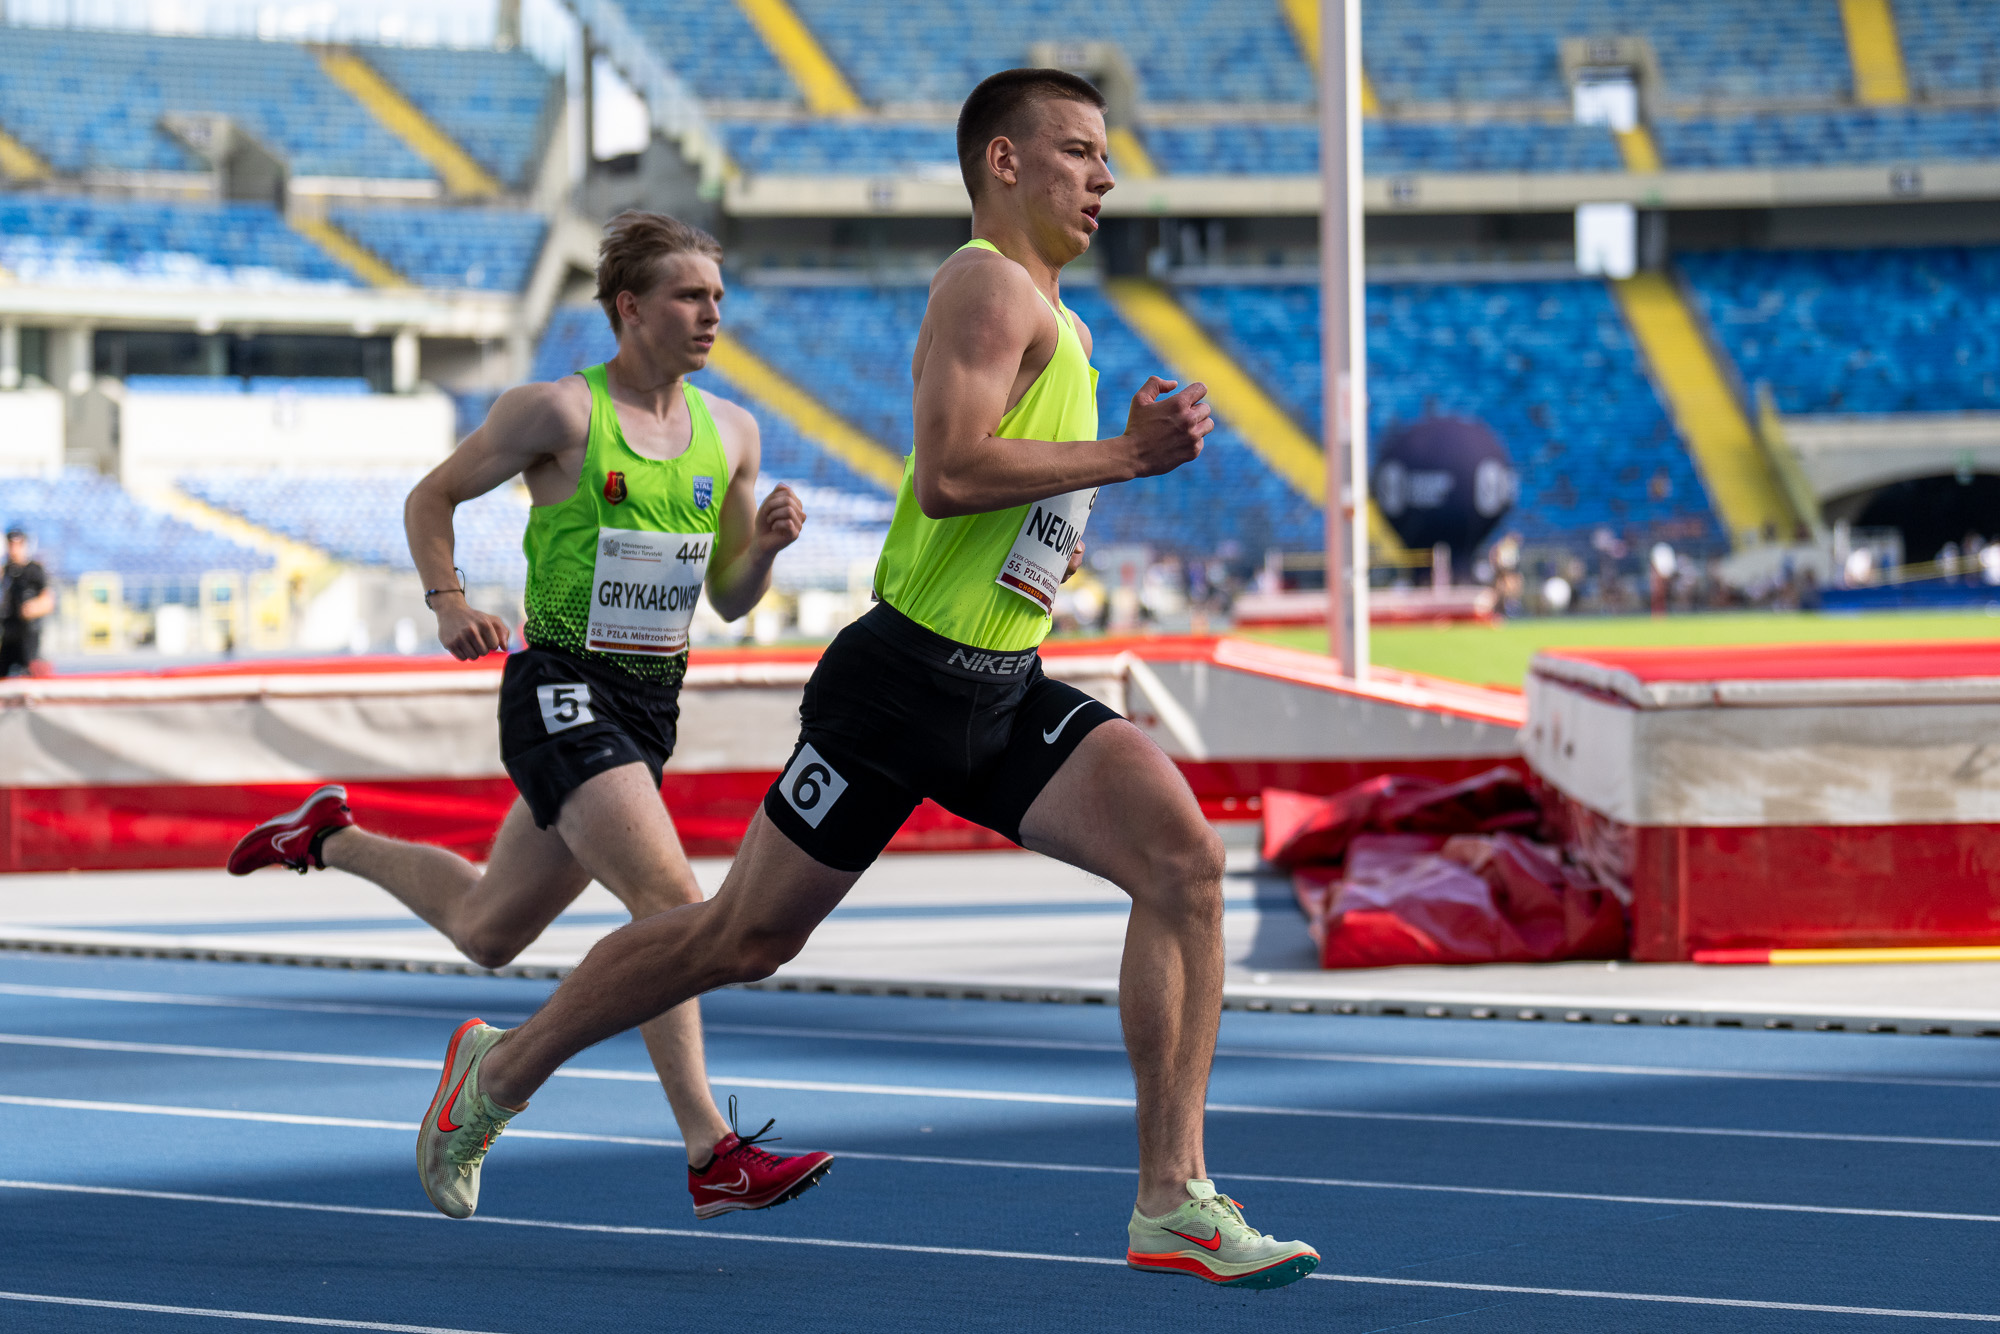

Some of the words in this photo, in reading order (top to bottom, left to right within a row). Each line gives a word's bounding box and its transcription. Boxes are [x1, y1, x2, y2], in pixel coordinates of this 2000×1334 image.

[621, 542, 653, 550] Ministerstwo
[1026, 506, 1081, 562] NEUM
[675, 541, 708, 565] 444
[1007, 560, 1021, 574] 55.
[1023, 567, 1041, 584] PZLA
[590, 628, 604, 638] 55.
[606, 630, 628, 640] PZLA
[630, 632, 676, 642] Mistrzostwa
[553, 688, 579, 723] 5
[792, 763, 831, 810] 6
